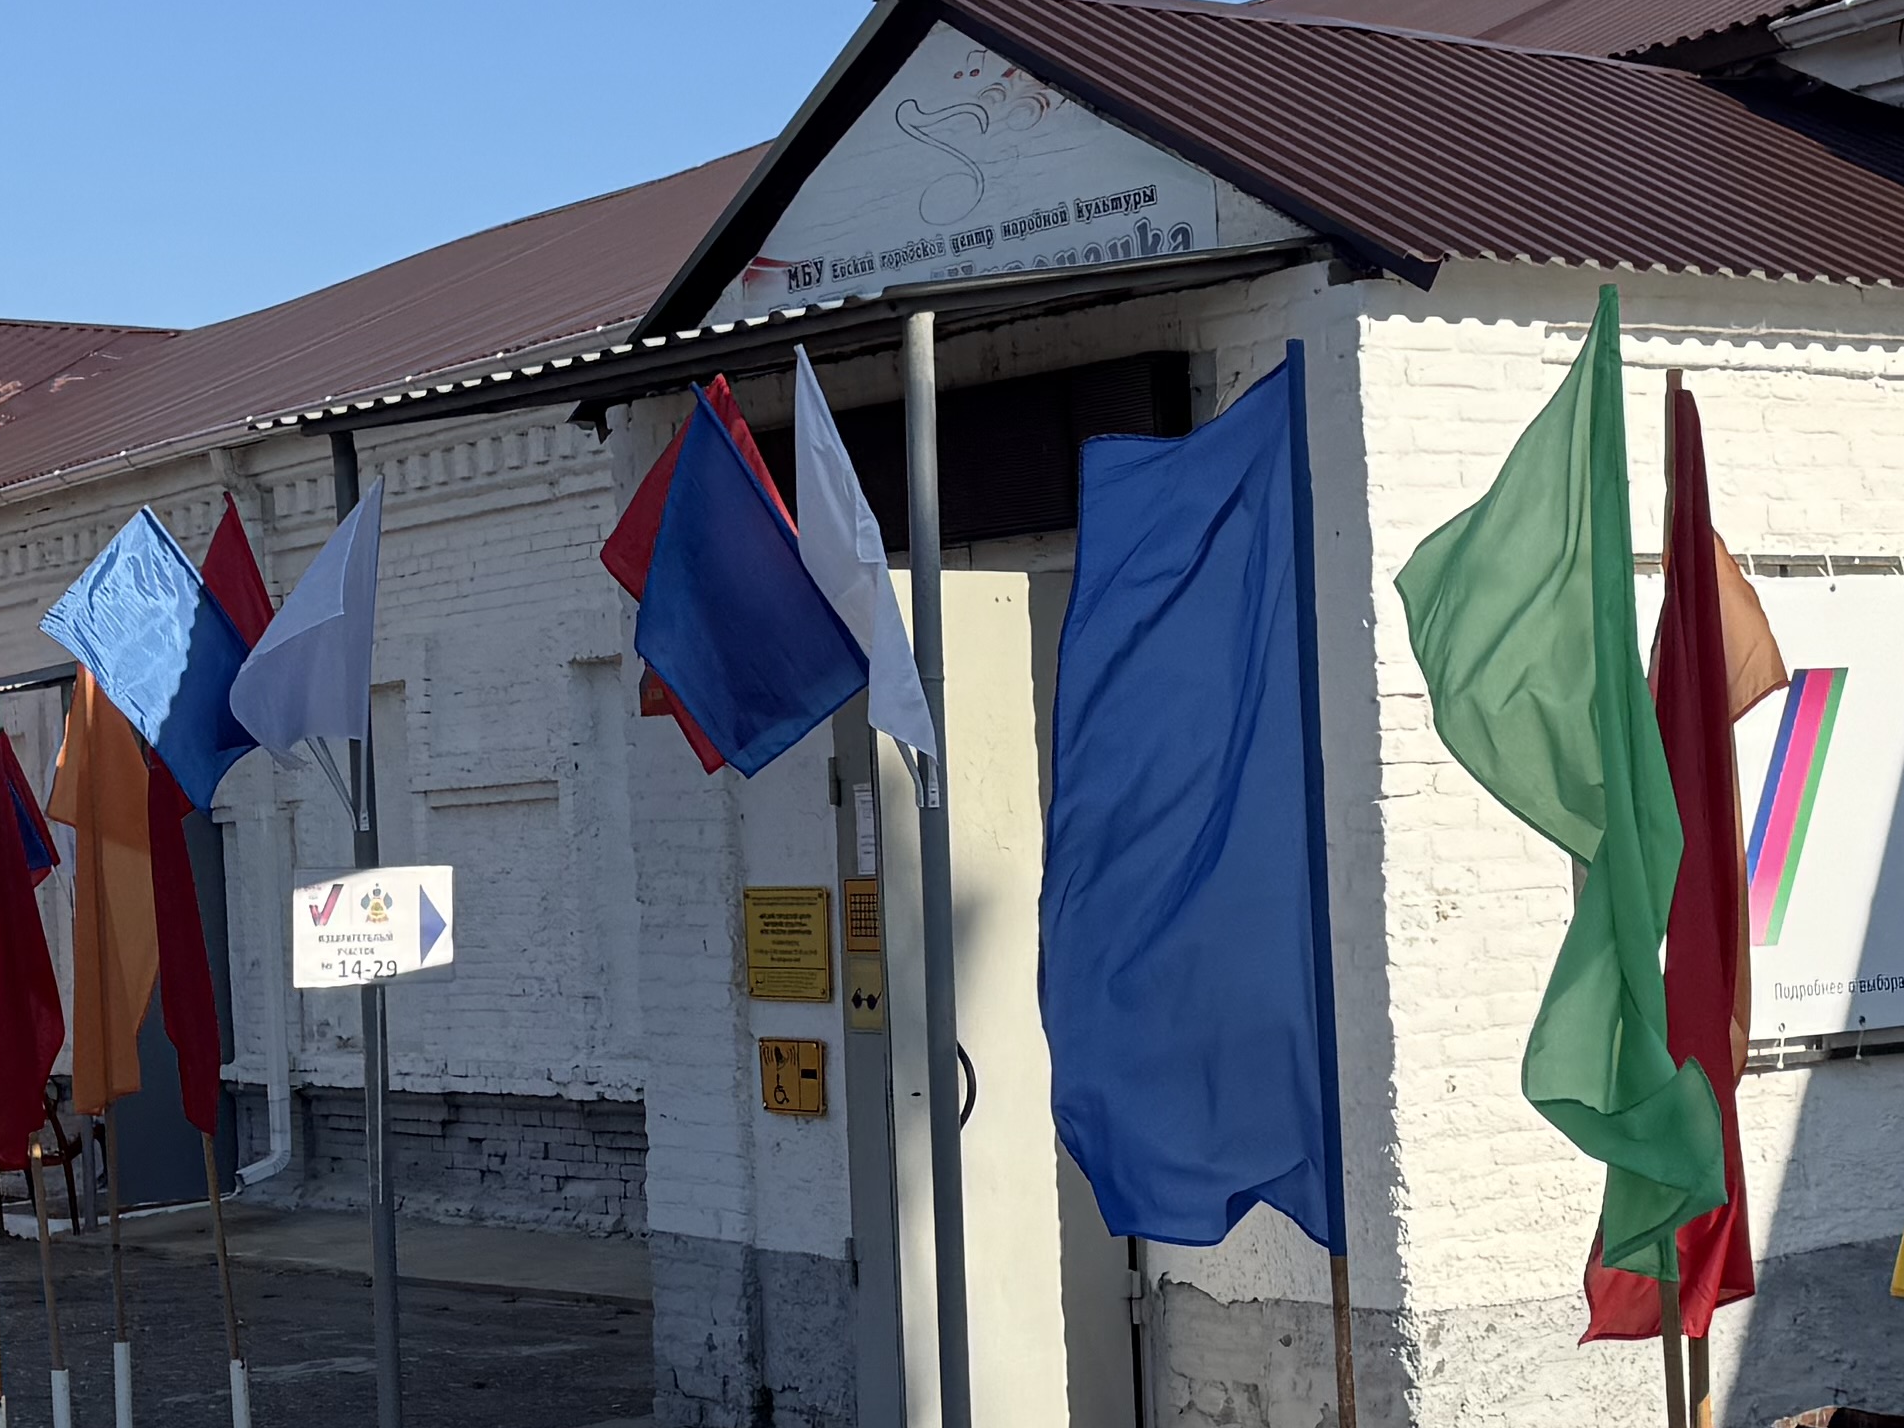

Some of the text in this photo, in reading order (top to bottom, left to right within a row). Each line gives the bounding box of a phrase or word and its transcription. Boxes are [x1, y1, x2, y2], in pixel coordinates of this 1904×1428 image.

[787, 257, 824, 293] МБУ
[950, 226, 994, 256] центр
[1001, 202, 1069, 240] народной
[1074, 184, 1158, 223] культуры
[338, 960, 397, 979] 14-29
[1774, 980, 1843, 1001] Подробнее
[1848, 981, 1856, 993] о
